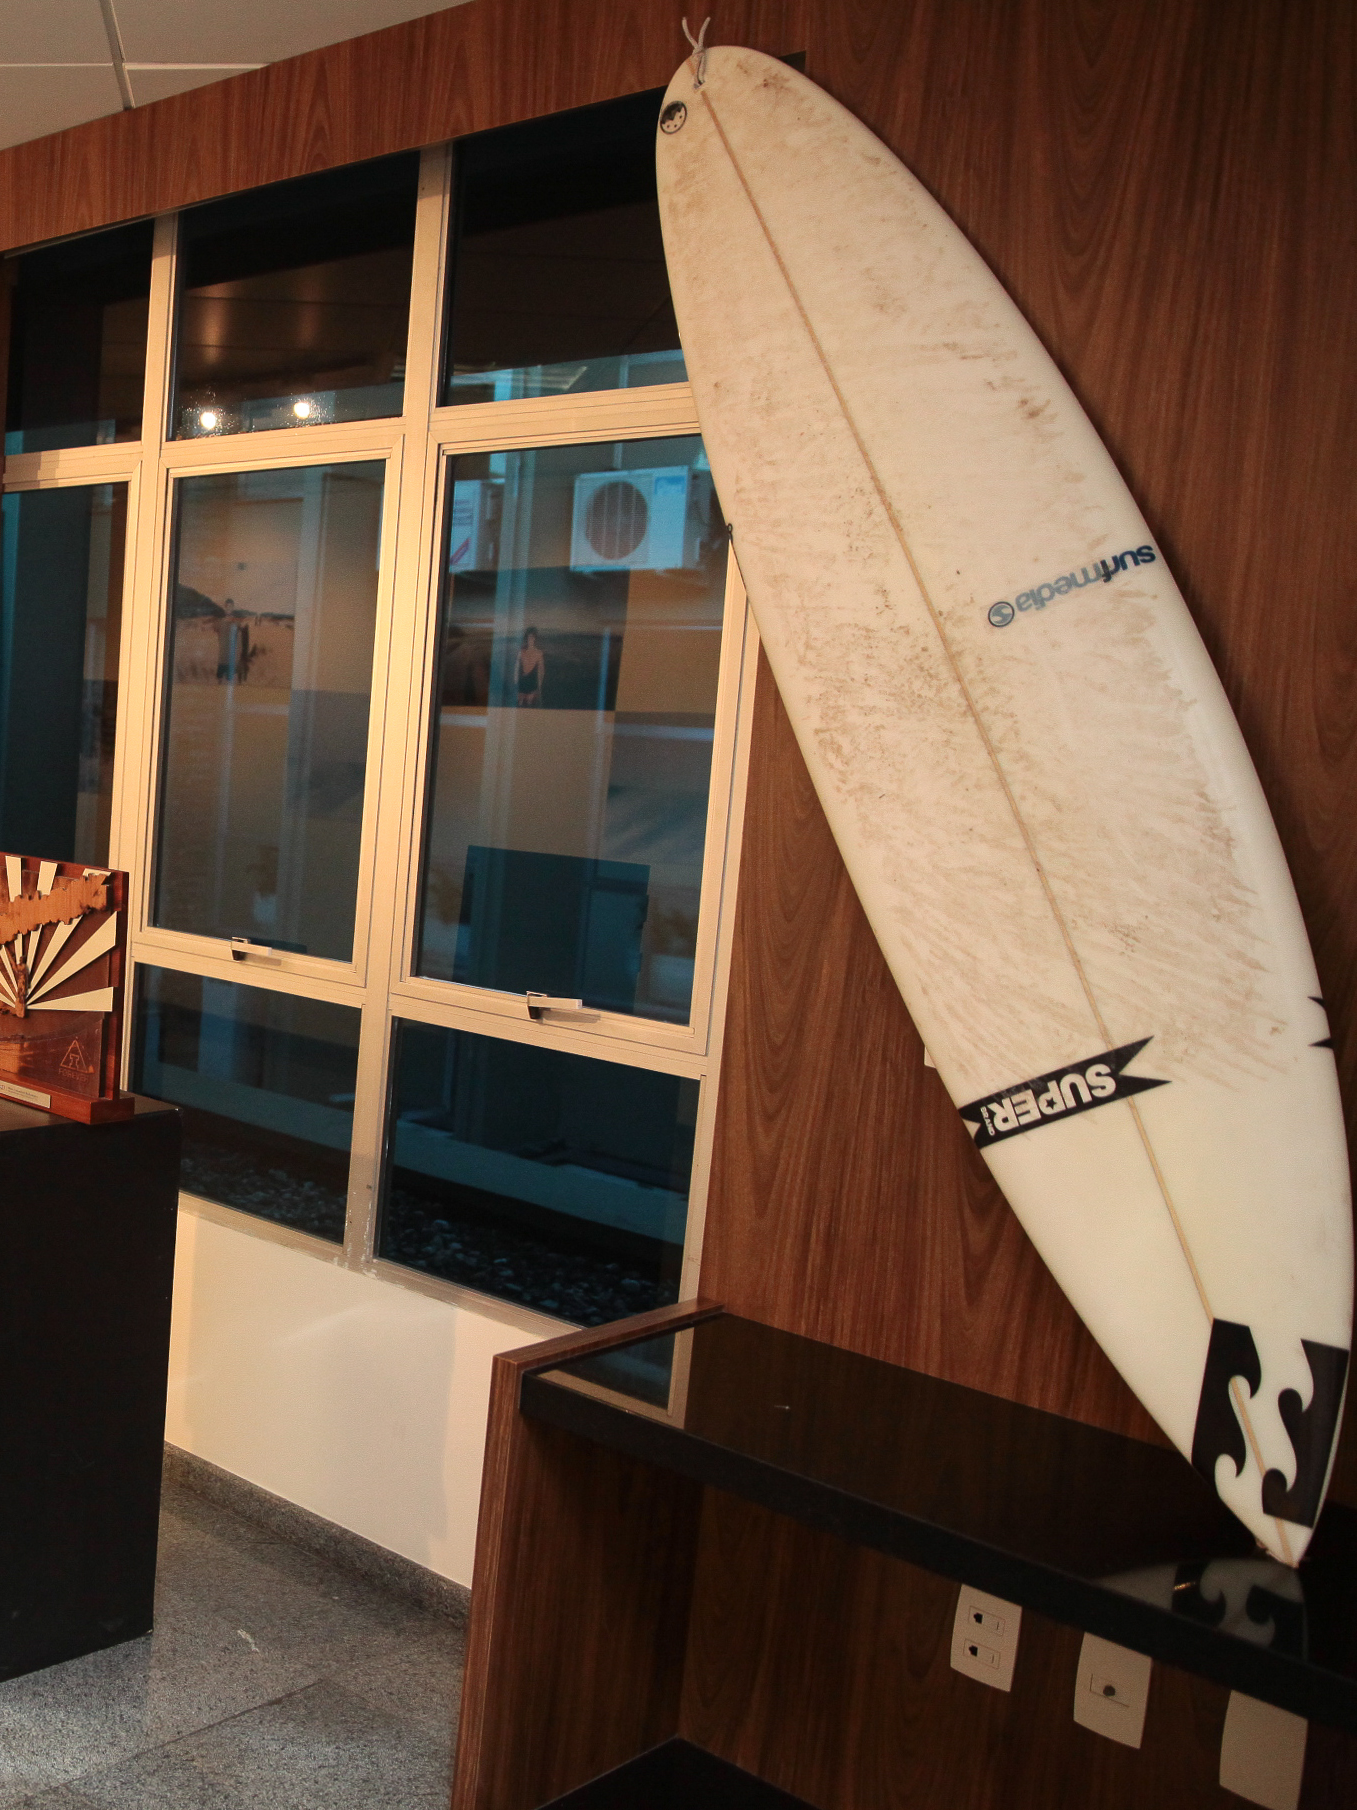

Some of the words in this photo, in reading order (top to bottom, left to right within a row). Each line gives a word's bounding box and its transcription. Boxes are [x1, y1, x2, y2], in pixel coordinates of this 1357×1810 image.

[1016, 545, 1157, 612] surfmedia
[58, 1068, 89, 1084] FOREVER
[988, 1063, 1116, 1132] SUPER
[980, 1106, 995, 1136] BRAND
